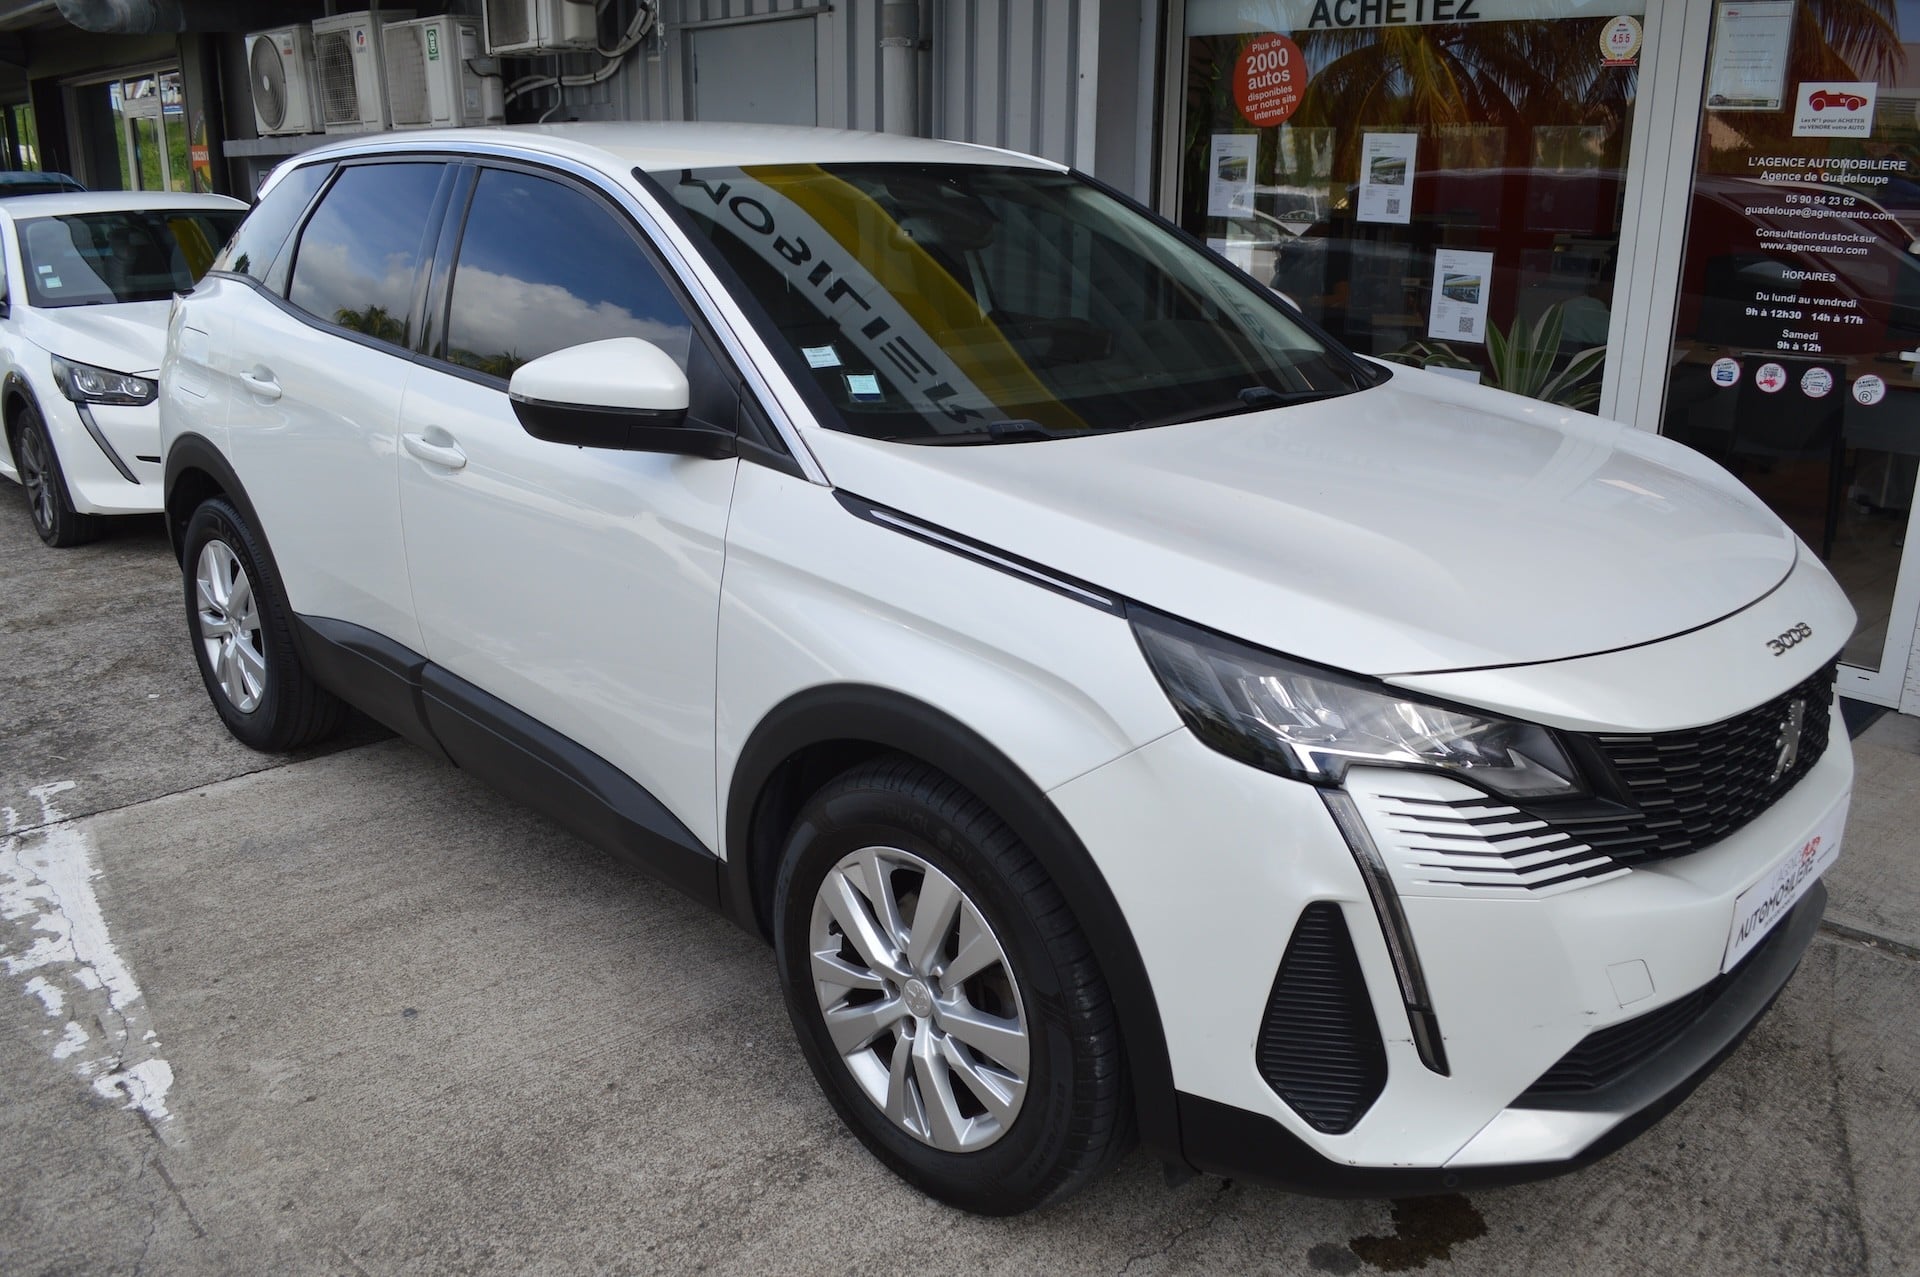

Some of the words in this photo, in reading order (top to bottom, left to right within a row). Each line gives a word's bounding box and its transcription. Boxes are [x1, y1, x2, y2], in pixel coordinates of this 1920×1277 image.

[1308, 0, 1479, 28] ACHETEZ
[1252, 43, 1269, 53] Plus
[1271, 39, 1280, 48] de
[1246, 48, 1289, 75] 2000
[1248, 69, 1291, 90] autos
[1248, 85, 1293, 102] disponibles
[1245, 104, 1260, 112] sur
[1260, 97, 1280, 108] notre
[1282, 94, 1296, 104] site
[1254, 106, 1284, 120] internet
[1748, 157, 1806, 168] L'AGENCE
[1807, 158, 1907, 171] AUTOMOBILIERE
[1760, 170, 1801, 183] Agence
[1804, 171, 1817, 182] de
[1820, 172, 1889, 185] Guadeloupe
[1785, 194, 1798, 203] 05
[1800, 195, 1812, 204] 90
[1814, 195, 1826, 205] 94
[1828, 196, 1840, 206] 23
[1843, 197, 1855, 206] 62
[1744, 206, 1895, 220] guadeloupe@agenceauto.com
[1760, 241, 1868, 255] www.agenceauto.com
[1782, 270, 1836, 282] HORAIRES
[1756, 291, 1769, 300] Du
[1772, 293, 1796, 303] lundi
[1798, 296, 1810, 304] au
[1813, 298, 1857, 308] vendredi
[1745, 307, 1758, 316] 9h
[1760, 308, 1767, 317] à
[1770, 309, 1802, 320] 12h30
[1811, 312, 1831, 322] 14h
[1833, 314, 1840, 323] à
[1844, 315, 1863, 324] 17h
[1782, 329, 1819, 341] Samedi
[1777, 340, 1790, 350] 9h
[1792, 342, 1800, 351] à
[1802, 343, 1822, 352] 12h
[1766, 622, 1812, 656] 3008
